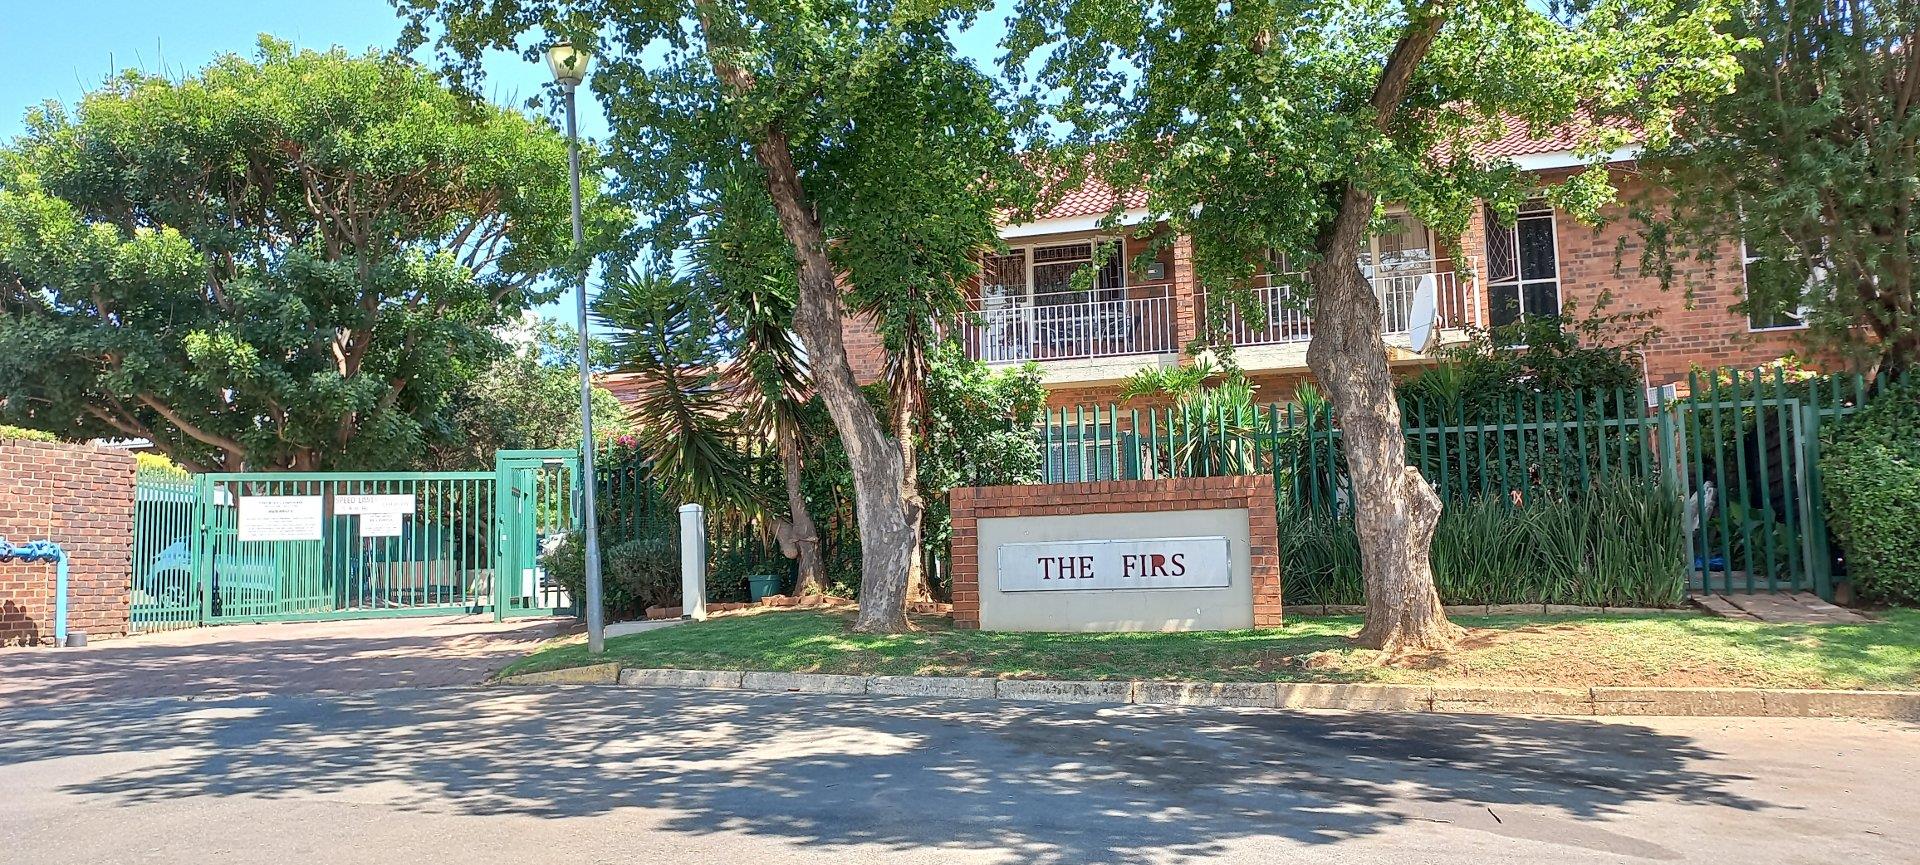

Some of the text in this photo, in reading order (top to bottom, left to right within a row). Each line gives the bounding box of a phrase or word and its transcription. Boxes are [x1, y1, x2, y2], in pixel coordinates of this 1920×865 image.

[358, 496, 377, 504] LIMI
[1037, 553, 1186, 580] THE FIRS
